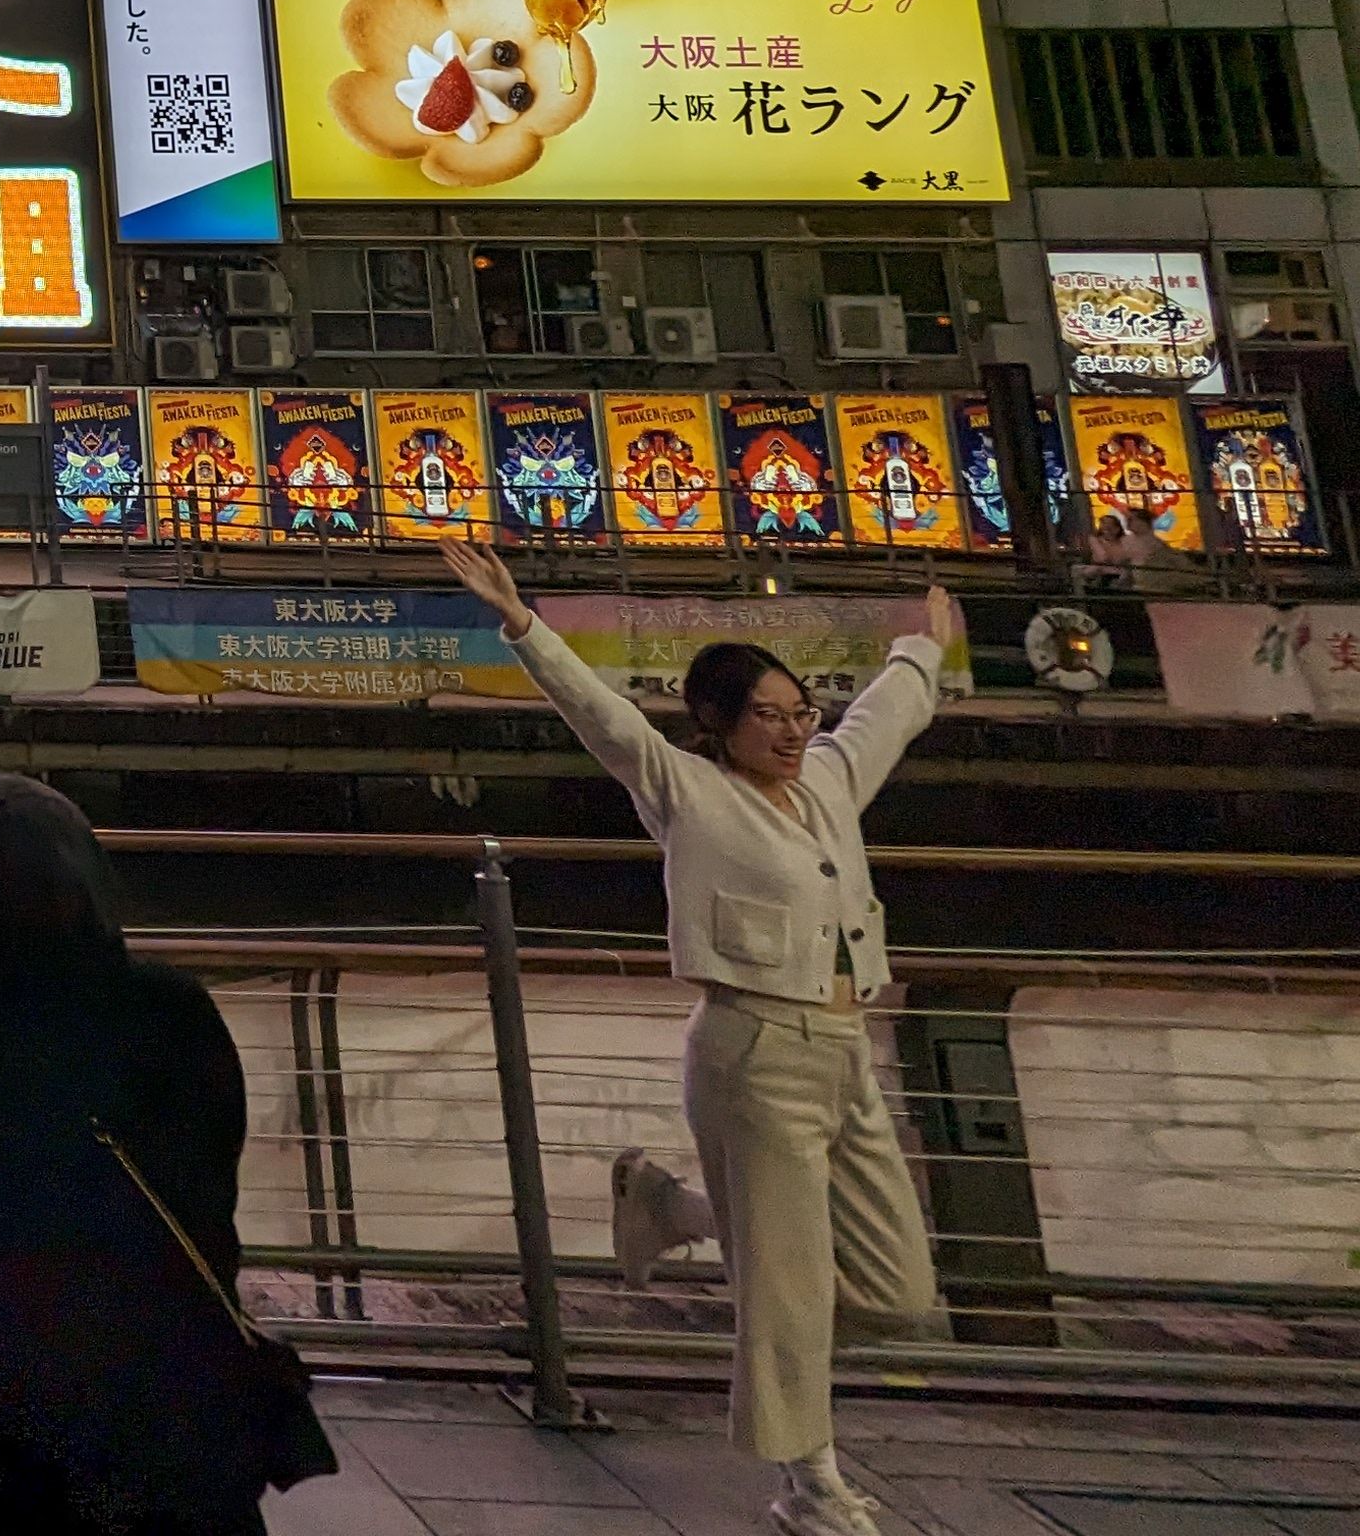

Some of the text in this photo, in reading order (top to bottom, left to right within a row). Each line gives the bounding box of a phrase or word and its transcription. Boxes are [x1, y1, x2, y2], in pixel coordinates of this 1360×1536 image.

[640, 35, 804, 70] 大阪土産
[648, 80, 977, 136] 大阪 花ラング
[54, 404, 132, 423] AWAKEN FIESTA
[162, 406, 240, 423] AWAKEN FIESTA
[278, 406, 357, 424] AWAKEN FIESTA
[388, 407, 467, 425] AWAKEN FIESTA
[505, 407, 586, 427] AWAKEN FIESTA
[272, 598, 397, 624] 東大阪大学
[217, 633, 460, 661] 東大阪大学短期大学部
